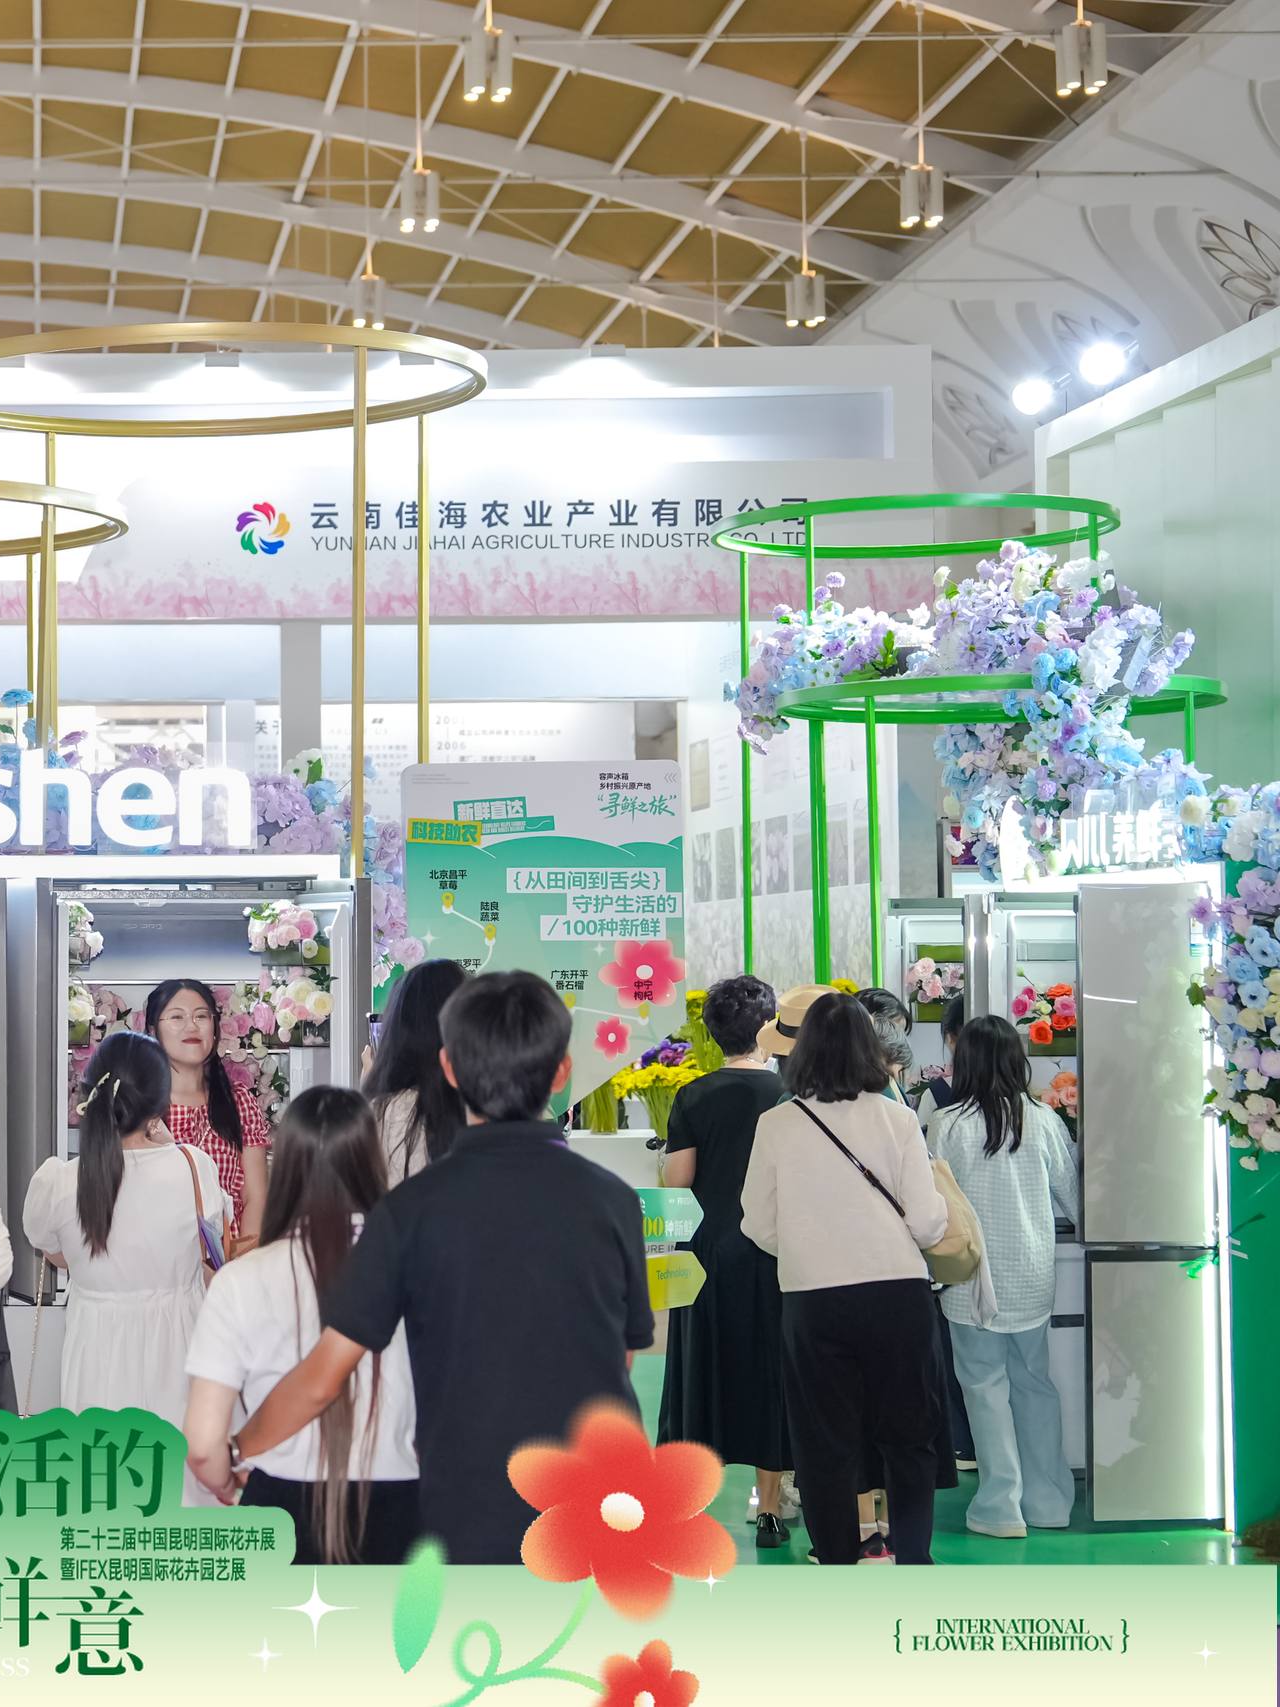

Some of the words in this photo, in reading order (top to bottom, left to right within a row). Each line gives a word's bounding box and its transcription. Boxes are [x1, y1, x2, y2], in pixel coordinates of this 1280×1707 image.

[311, 535, 396, 551] YUNAN
[402, 535, 465, 551] JIHAI
[471, 533, 615, 551] AGRICULTURE
[621, 532, 712, 549] INDUSTR
[598, 772, 630, 781] 容声冰箱
[598, 782, 652, 791] 乡村振兴原产地
[411, 821, 479, 843] 科技助农
[429, 869, 468, 880] 北京昌平
[438, 880, 458, 891] 草莓
[480, 901, 500, 911] 陆良
[572, 894, 677, 915] 守护生活的
[480, 912, 500, 922] 蔬菜
[550, 969, 589, 981] 广东开平
[555, 980, 585, 991] 番石榴
[633, 980, 653, 991] 中宁
[633, 991, 654, 1001] 枸杞
